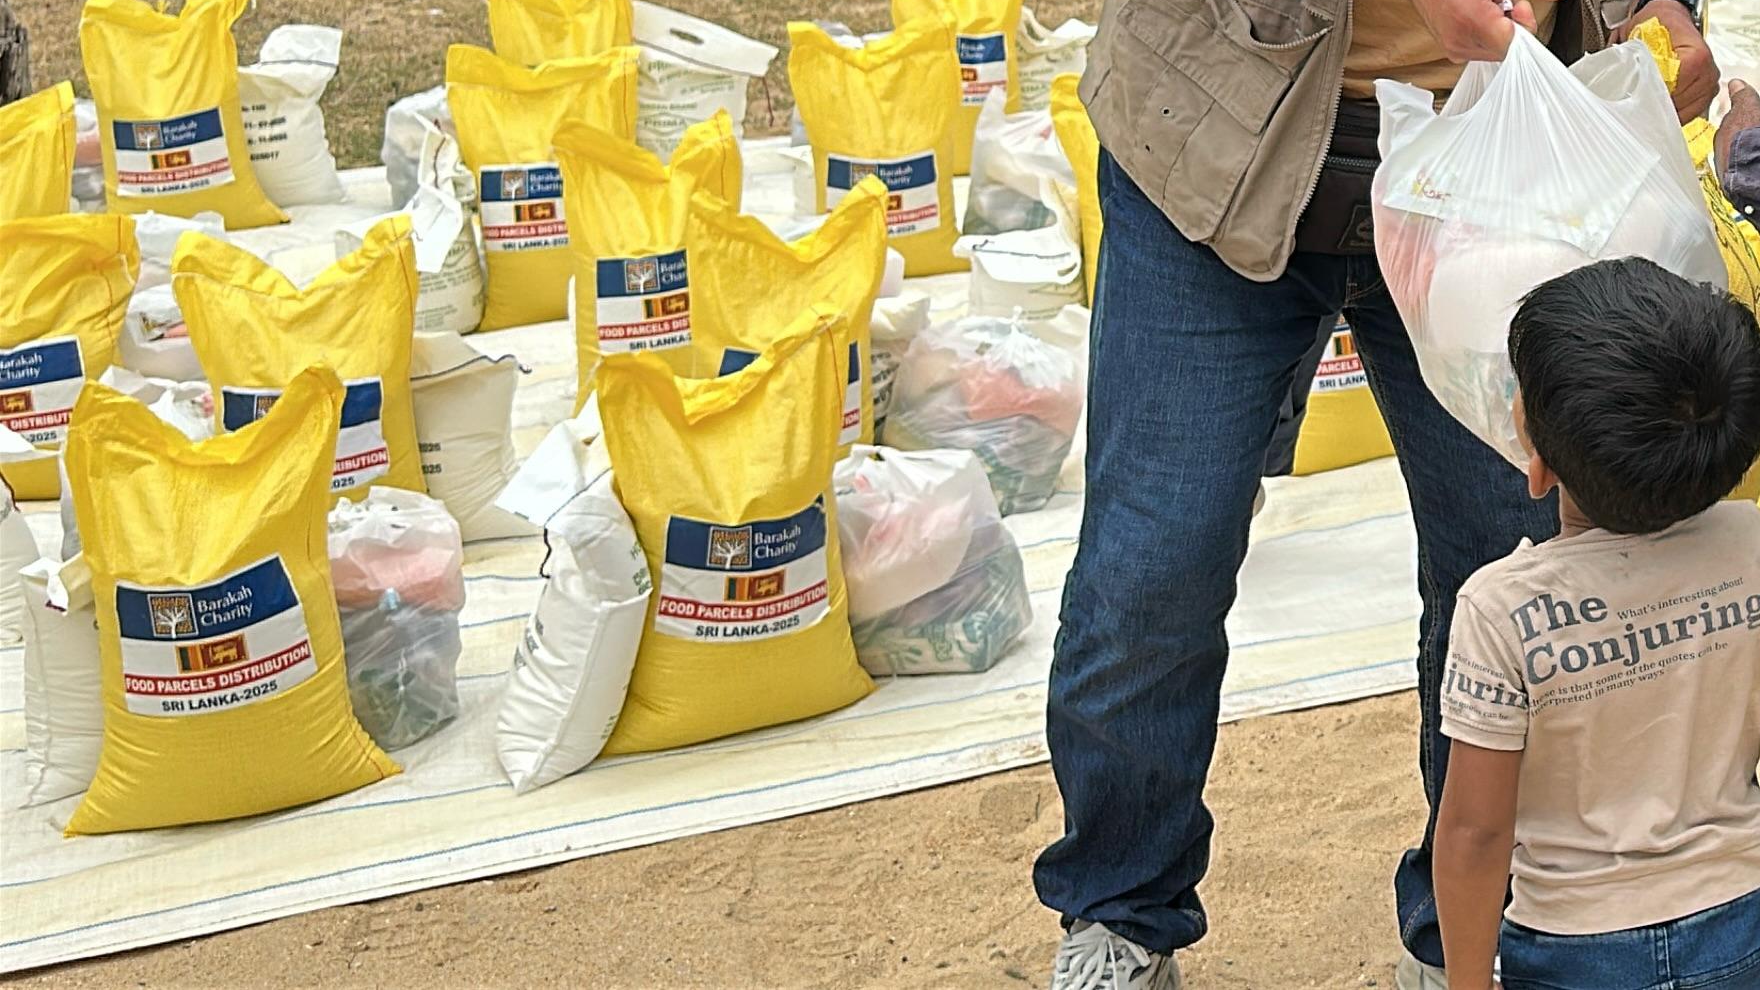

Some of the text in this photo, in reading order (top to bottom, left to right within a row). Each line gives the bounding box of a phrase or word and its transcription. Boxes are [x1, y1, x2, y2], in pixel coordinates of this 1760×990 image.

[626, 321, 670, 337] PARCELS
[630, 341, 647, 350] SRI
[0, 352, 43, 370] arakah
[1338, 374, 1367, 386] LANK
[10, 412, 69, 430] DISTRIBUT
[754, 524, 802, 545] Barakah
[754, 540, 799, 560] Charity
[197, 585, 253, 614] Barakah
[661, 583, 828, 619] FOOD PARCELS DISTRIBUTION
[1617, 576, 1744, 621] What's interesting about
[200, 602, 254, 627] Charity
[696, 614, 801, 638] SRI LANKA-2025
[1510, 592, 1609, 643] The
[126, 643, 309, 693] FOOD PARCELS DISTRIBUTION
[1558, 684, 1569, 696] is
[1570, 681, 1594, 694] that
[1595, 672, 1624, 688] some
[1625, 666, 1639, 678] of
[1639, 661, 1657, 674] the
[1658, 651, 1696, 670] quotes
[1714, 640, 1729, 652] be
[161, 679, 278, 712] SRI LANKA-2025
[1445, 662, 1529, 711] jurin
[1594, 685, 1605, 698] in
[1606, 676, 1636, 693] many
[1638, 667, 1665, 683] ways
